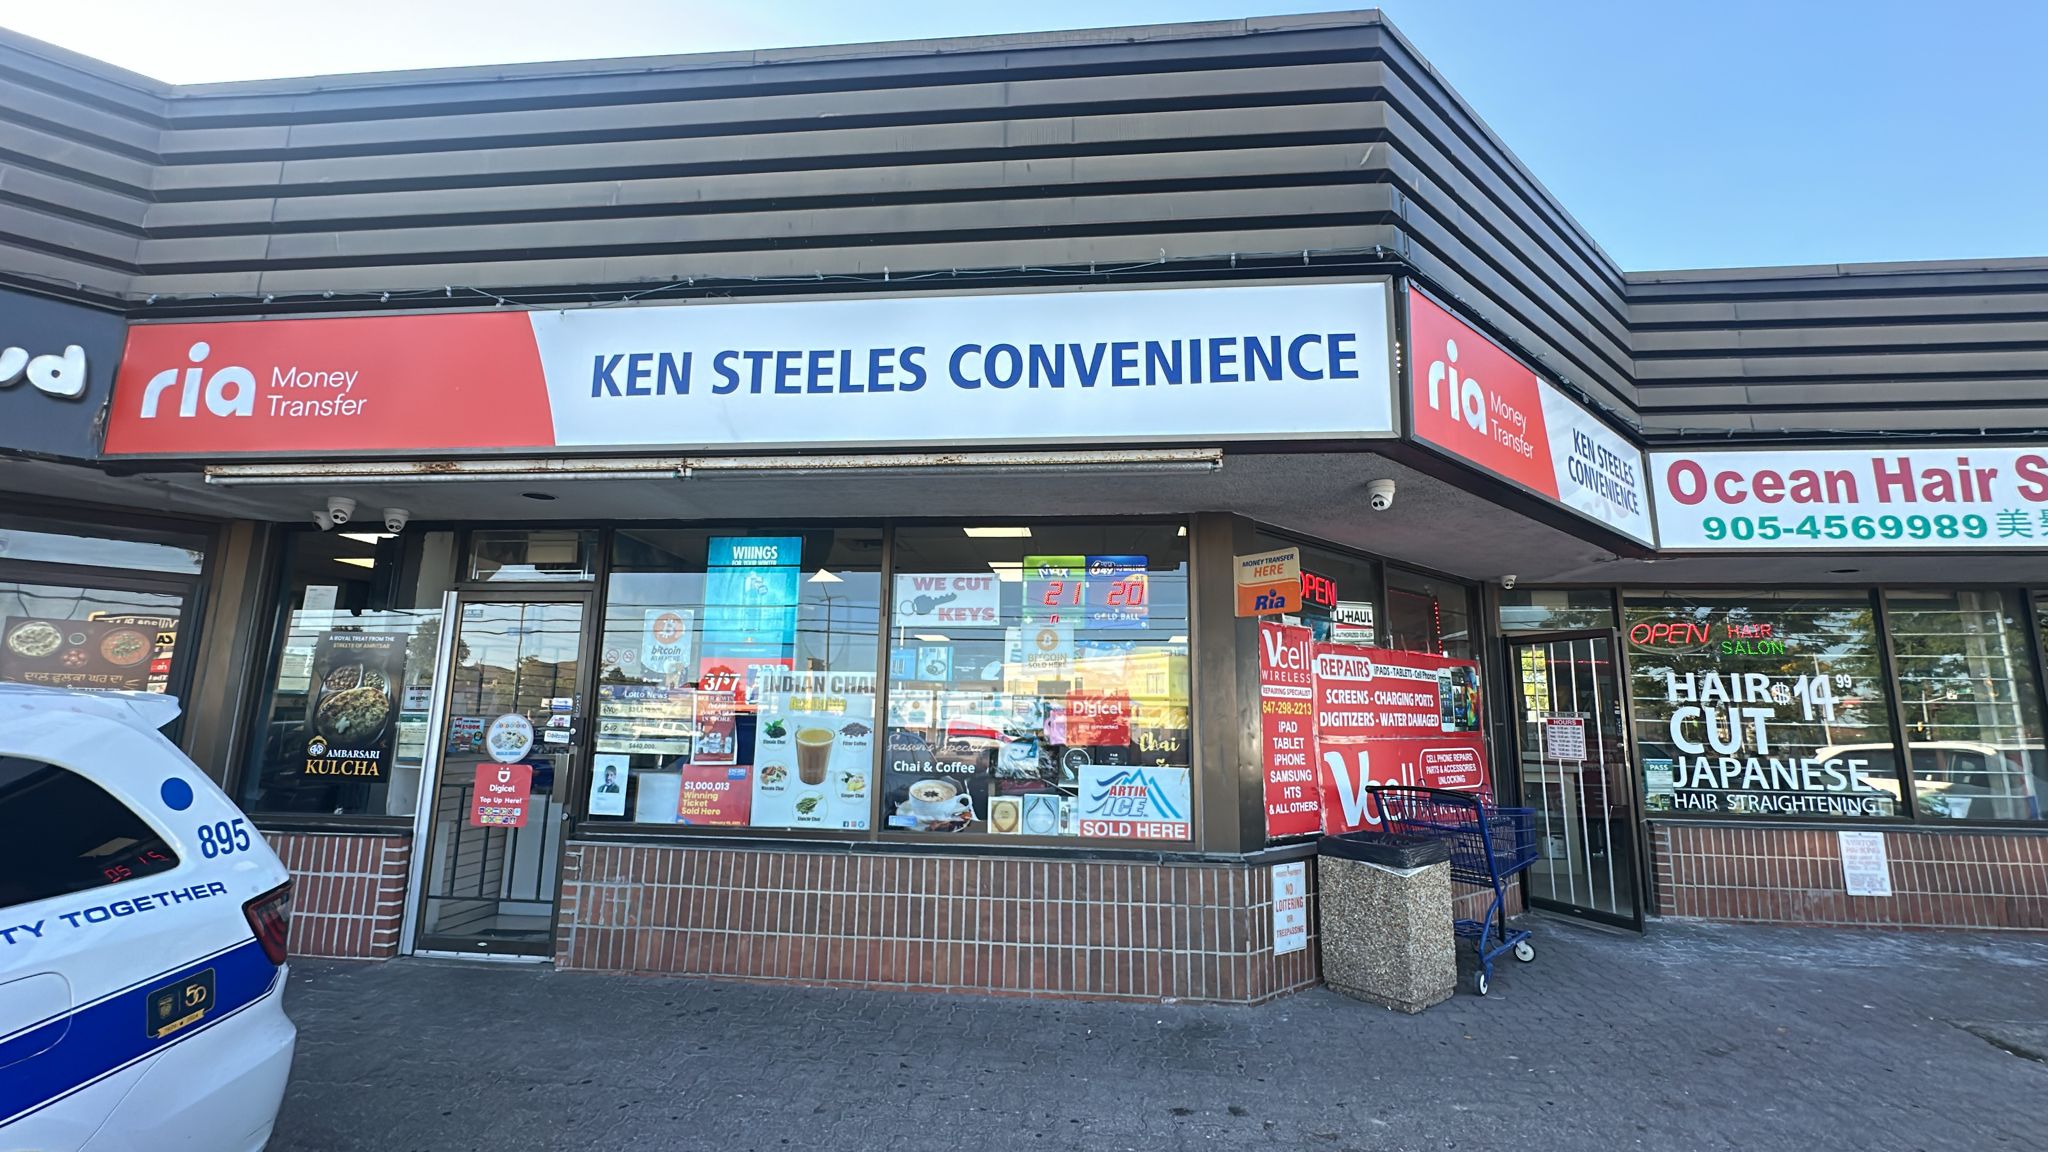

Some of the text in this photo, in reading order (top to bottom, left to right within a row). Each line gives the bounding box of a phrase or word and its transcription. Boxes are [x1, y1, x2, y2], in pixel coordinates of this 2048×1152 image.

[591, 332, 1359, 397] KEN STEELES CONVENIENCE
[140, 342, 256, 418] ria
[271, 367, 358, 393] Money
[1429, 338, 1487, 435] ria
[266, 394, 367, 417] Transfer
[1490, 391, 1526, 433] Money
[1491, 419, 1533, 459] Transfer
[1572, 428, 1634, 487] KEN STEELES
[1568, 456, 1640, 516] CONVENIENCE
[1666, 459, 1859, 506] Ocean
[1871, 457, 1998, 503] Hair
[1702, 514, 1988, 541] 905-4569989
[733, 546, 778, 560] WIIINGS
[1242, 553, 1294, 567] MONEY TRANSFER
[1254, 563, 1284, 578] HERE
[913, 577, 993, 590] WE CUT
[1044, 580, 1081, 605] 21
[1106, 580, 1144, 605] 20
[1254, 589, 1286, 611] Ria
[938, 607, 995, 621] KEYS
[1336, 611, 1372, 623] U-HAUL
[1630, 623, 1710, 645] OPEN
[1727, 624, 1772, 639] HAIR
[651, 645, 681, 655] bitcoin
[1262, 629, 1310, 670] Vcell
[1721, 640, 1785, 655] SALON
[1320, 658, 1370, 678] REPAIRS
[1393, 667, 1412, 678] TABLETS
[1414, 670, 1422, 679] Cell
[1422, 671, 1437, 681] Phones
[762, 675, 825, 693] INDIAN
[1261, 670, 1311, 684] WIRELESS
[1666, 672, 1774, 703] HAIR
[1836, 674, 1852, 688] 99
[1326, 689, 1434, 707] SCREENS CHARGING PORTS
[1073, 701, 1123, 717] Digicel
[1262, 701, 1312, 715] 647-298-2213
[1278, 721, 1298, 733] iPAD
[1320, 711, 1439, 727] DIGITIZERS WATER DAMAGED
[1670, 706, 1775, 755] CUT
[1140, 731, 1180, 752] Chai
[1273, 737, 1304, 749] TABLET
[326, 749, 381, 759] AMBARSARI
[1274, 753, 1306, 766] iPHONE
[1426, 753, 1473, 763] CELL PHONE REPAIRS
[305, 759, 379, 776] KULCHA
[894, 761, 976, 773] Chai & Coffee
[1425, 766, 1440, 774] PARTS
[1444, 763, 1477, 773] ACCESSORIES
[1672, 756, 1873, 792] JAPANESE
[1270, 769, 1312, 783] SAMSUNG
[1437, 775, 1466, 785] UNLOCKING
[489, 784, 516, 794] Digicel
[684, 781, 730, 792] $1,000,013
[1109, 785, 1148, 797] ARTIK
[1284, 786, 1302, 799] HTS
[480, 796, 492, 804] Top
[493, 797, 503, 805] Up
[683, 791, 719, 801] Winning
[1674, 793, 1876, 813] HAIR STRAIGHTENING
[1102, 795, 1148, 817] ICE
[1269, 801, 1318, 815] & ALL OTHERS
[197, 818, 251, 859] 895
[1083, 821, 1186, 840] SOLD HERE
[1286, 883, 1294, 895] NO
[59, 881, 228, 928] TOGETHER
[1276, 896, 1304, 913] LOITERING
[1276, 925, 1305, 938] TRESPASSING
